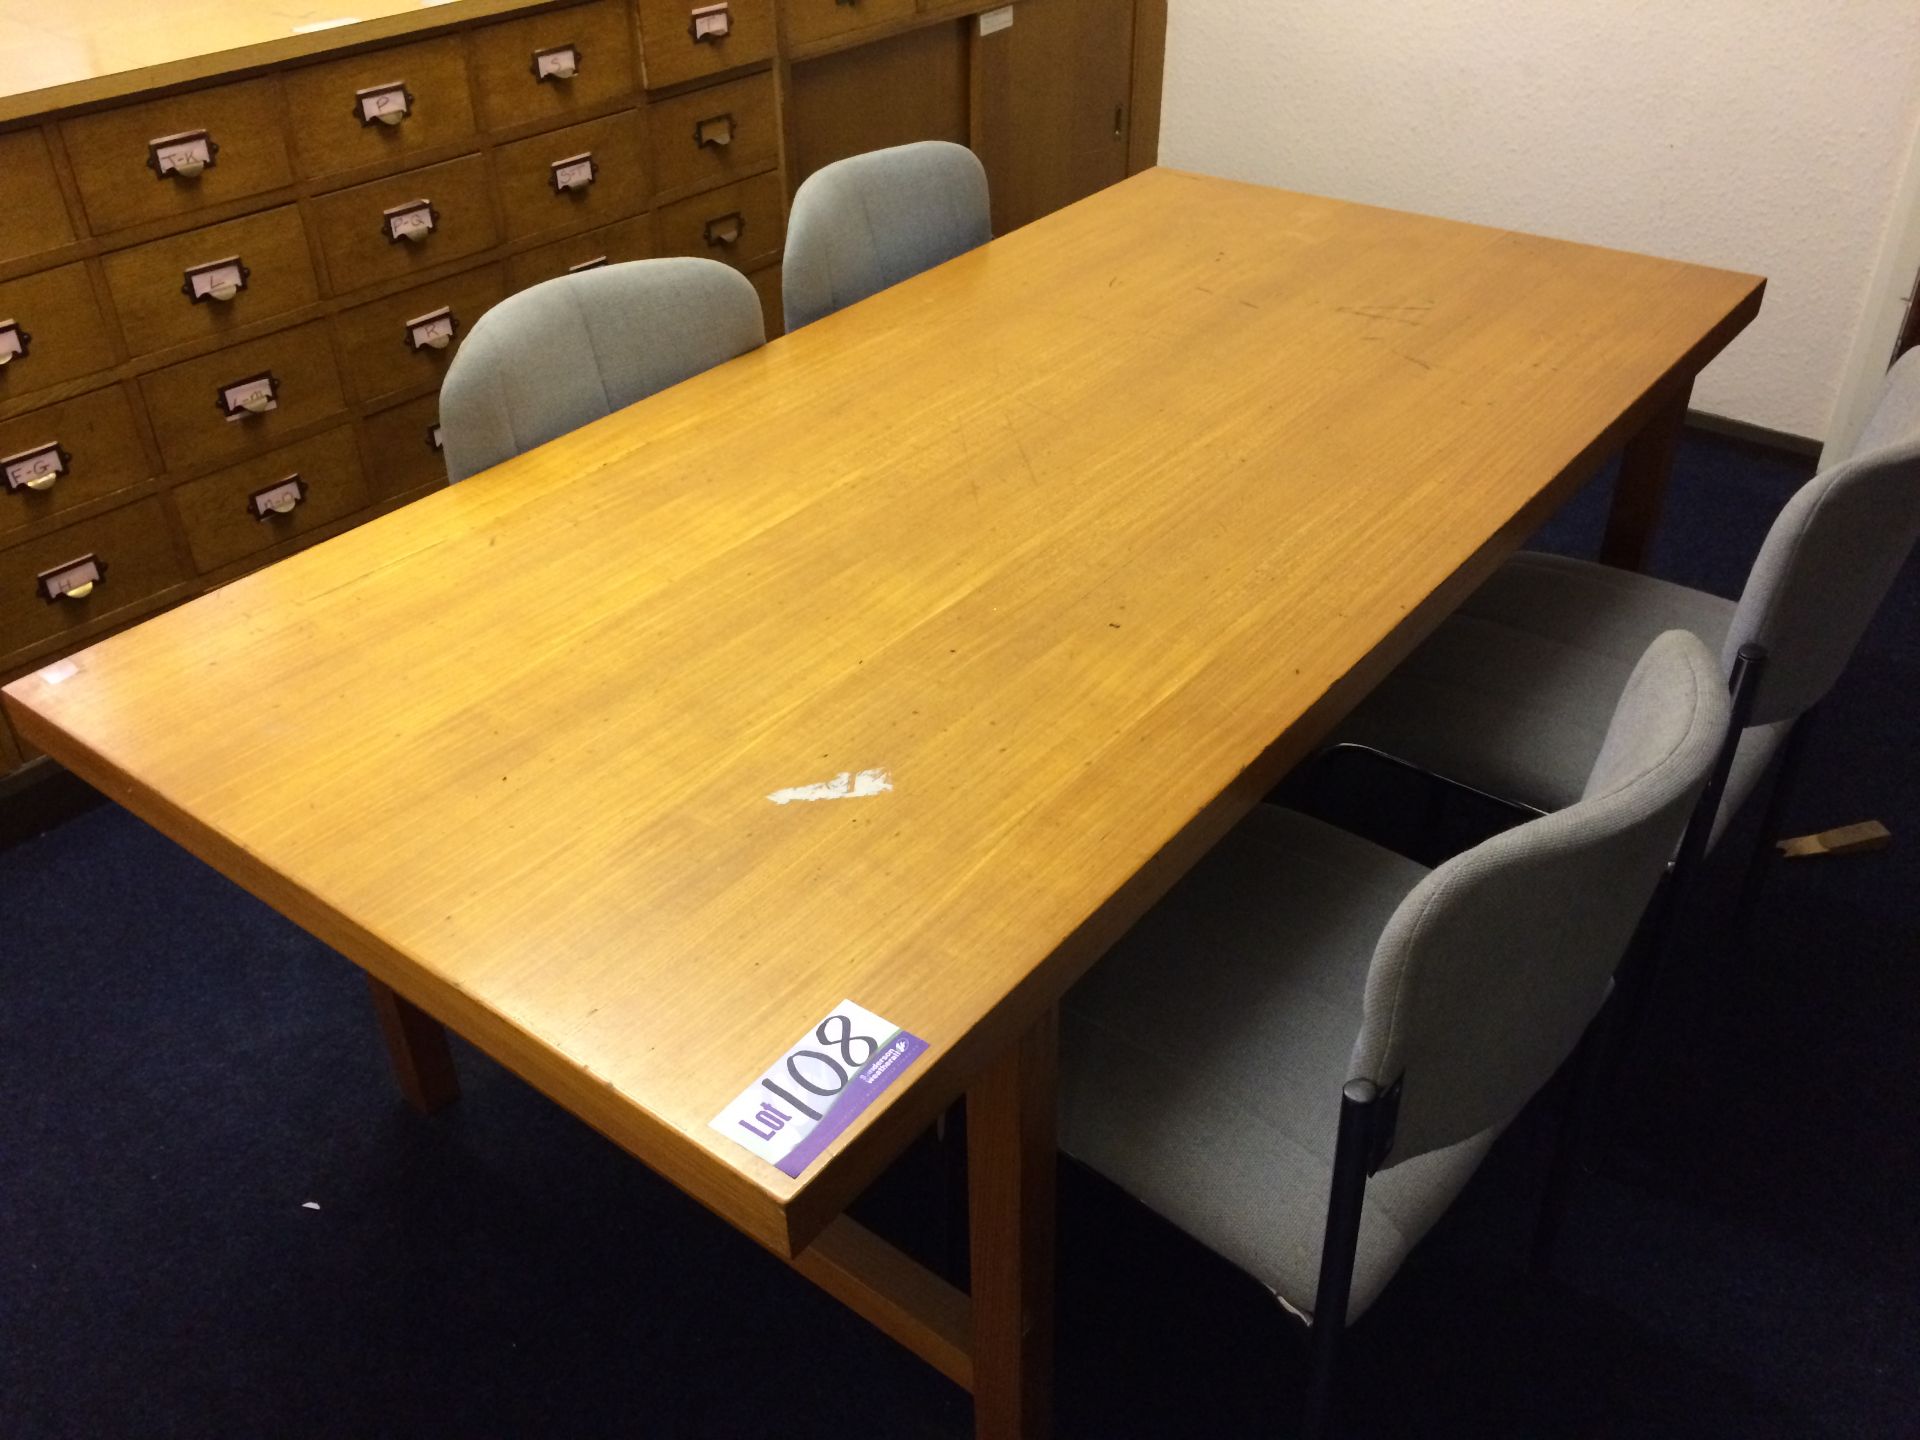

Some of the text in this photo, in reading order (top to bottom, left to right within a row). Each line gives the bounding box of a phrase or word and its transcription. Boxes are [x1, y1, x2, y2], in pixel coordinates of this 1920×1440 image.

[550, 57, 562, 71] S
[375, 95, 390, 112] P
[392, 213, 425, 233] P-Q
[210, 274, 226, 290] L
[424, 323, 439, 339] R
[11, 460, 51, 485] F-G
[761, 1014, 879, 1122] 108
[738, 1101, 793, 1142] Lot
